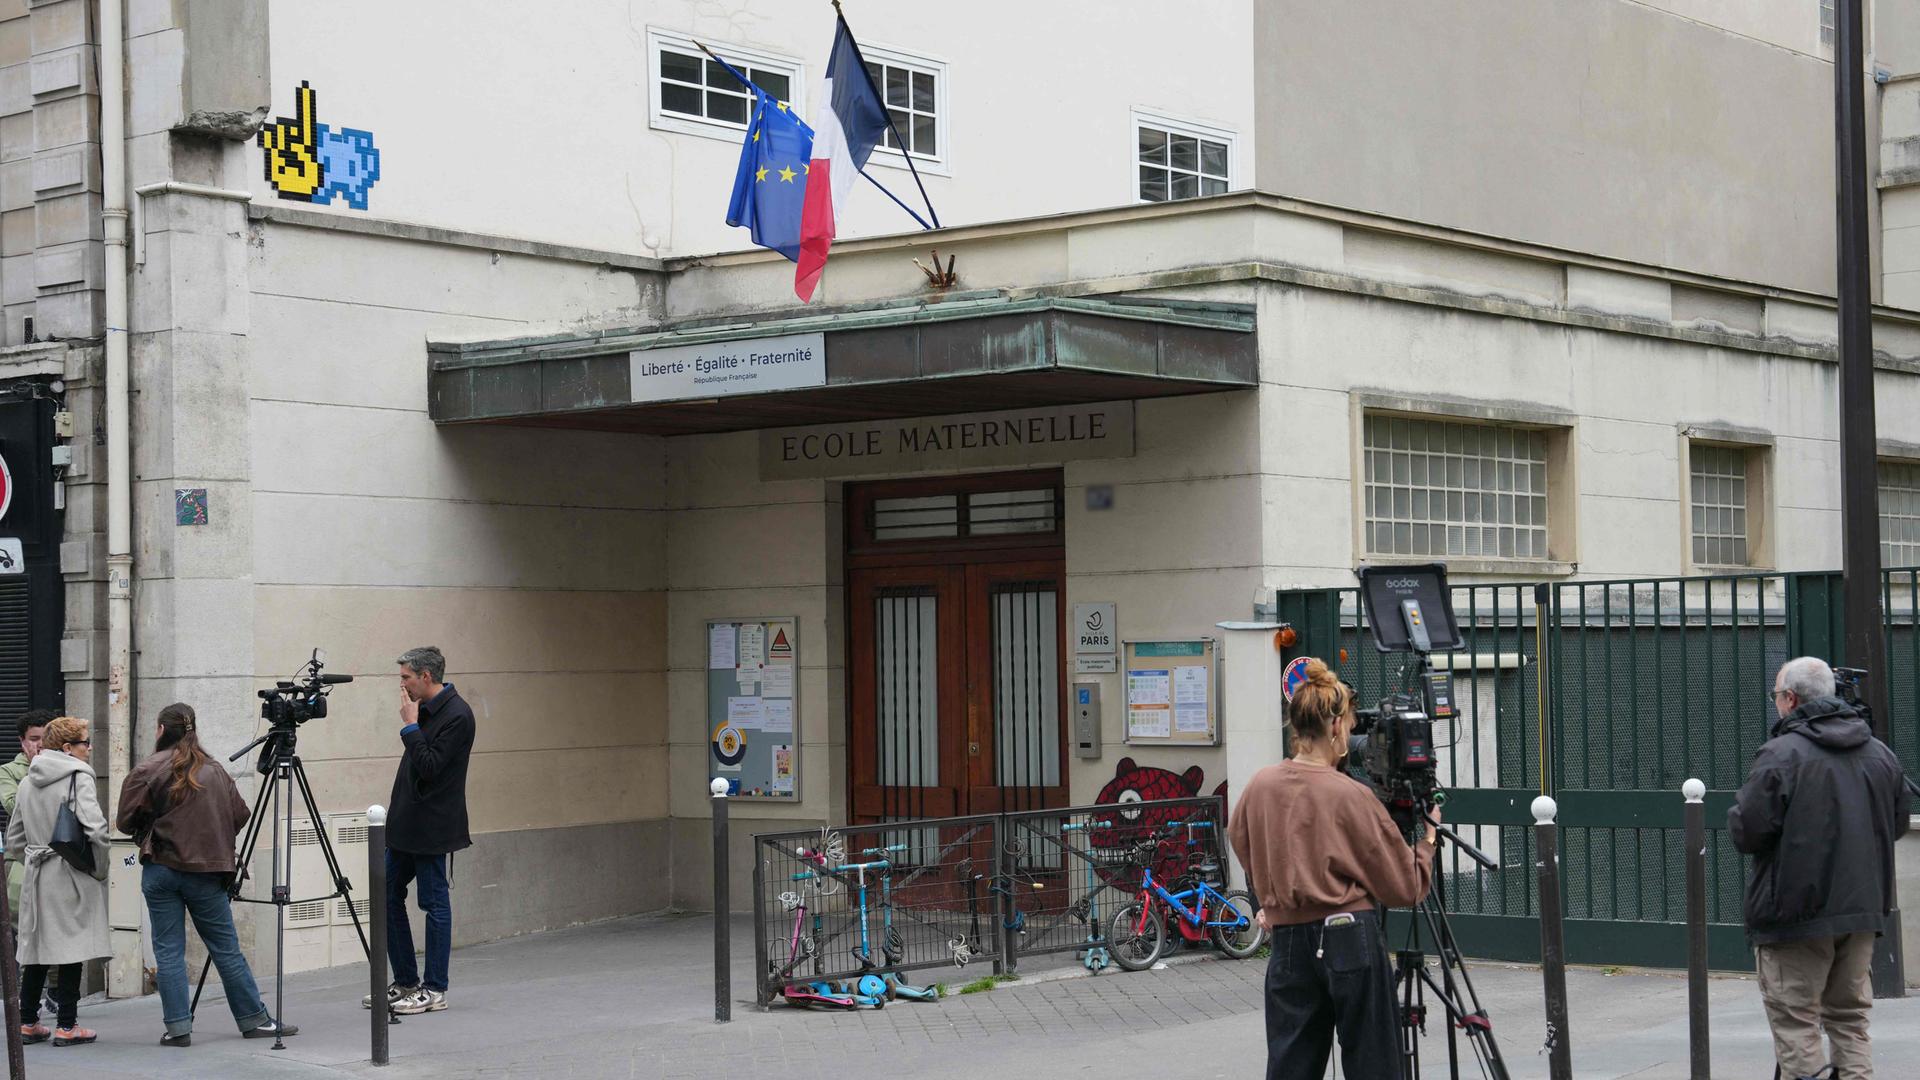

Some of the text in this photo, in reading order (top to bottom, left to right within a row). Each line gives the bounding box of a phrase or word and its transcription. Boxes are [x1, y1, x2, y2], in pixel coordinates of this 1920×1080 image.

[642, 347, 812, 377] Liberté Égalité Fraternité
[694, 372, 757, 384] République Française
[782, 413, 1107, 461] ECOLE MATERNELLE
[1385, 577, 1420, 588] Godox
